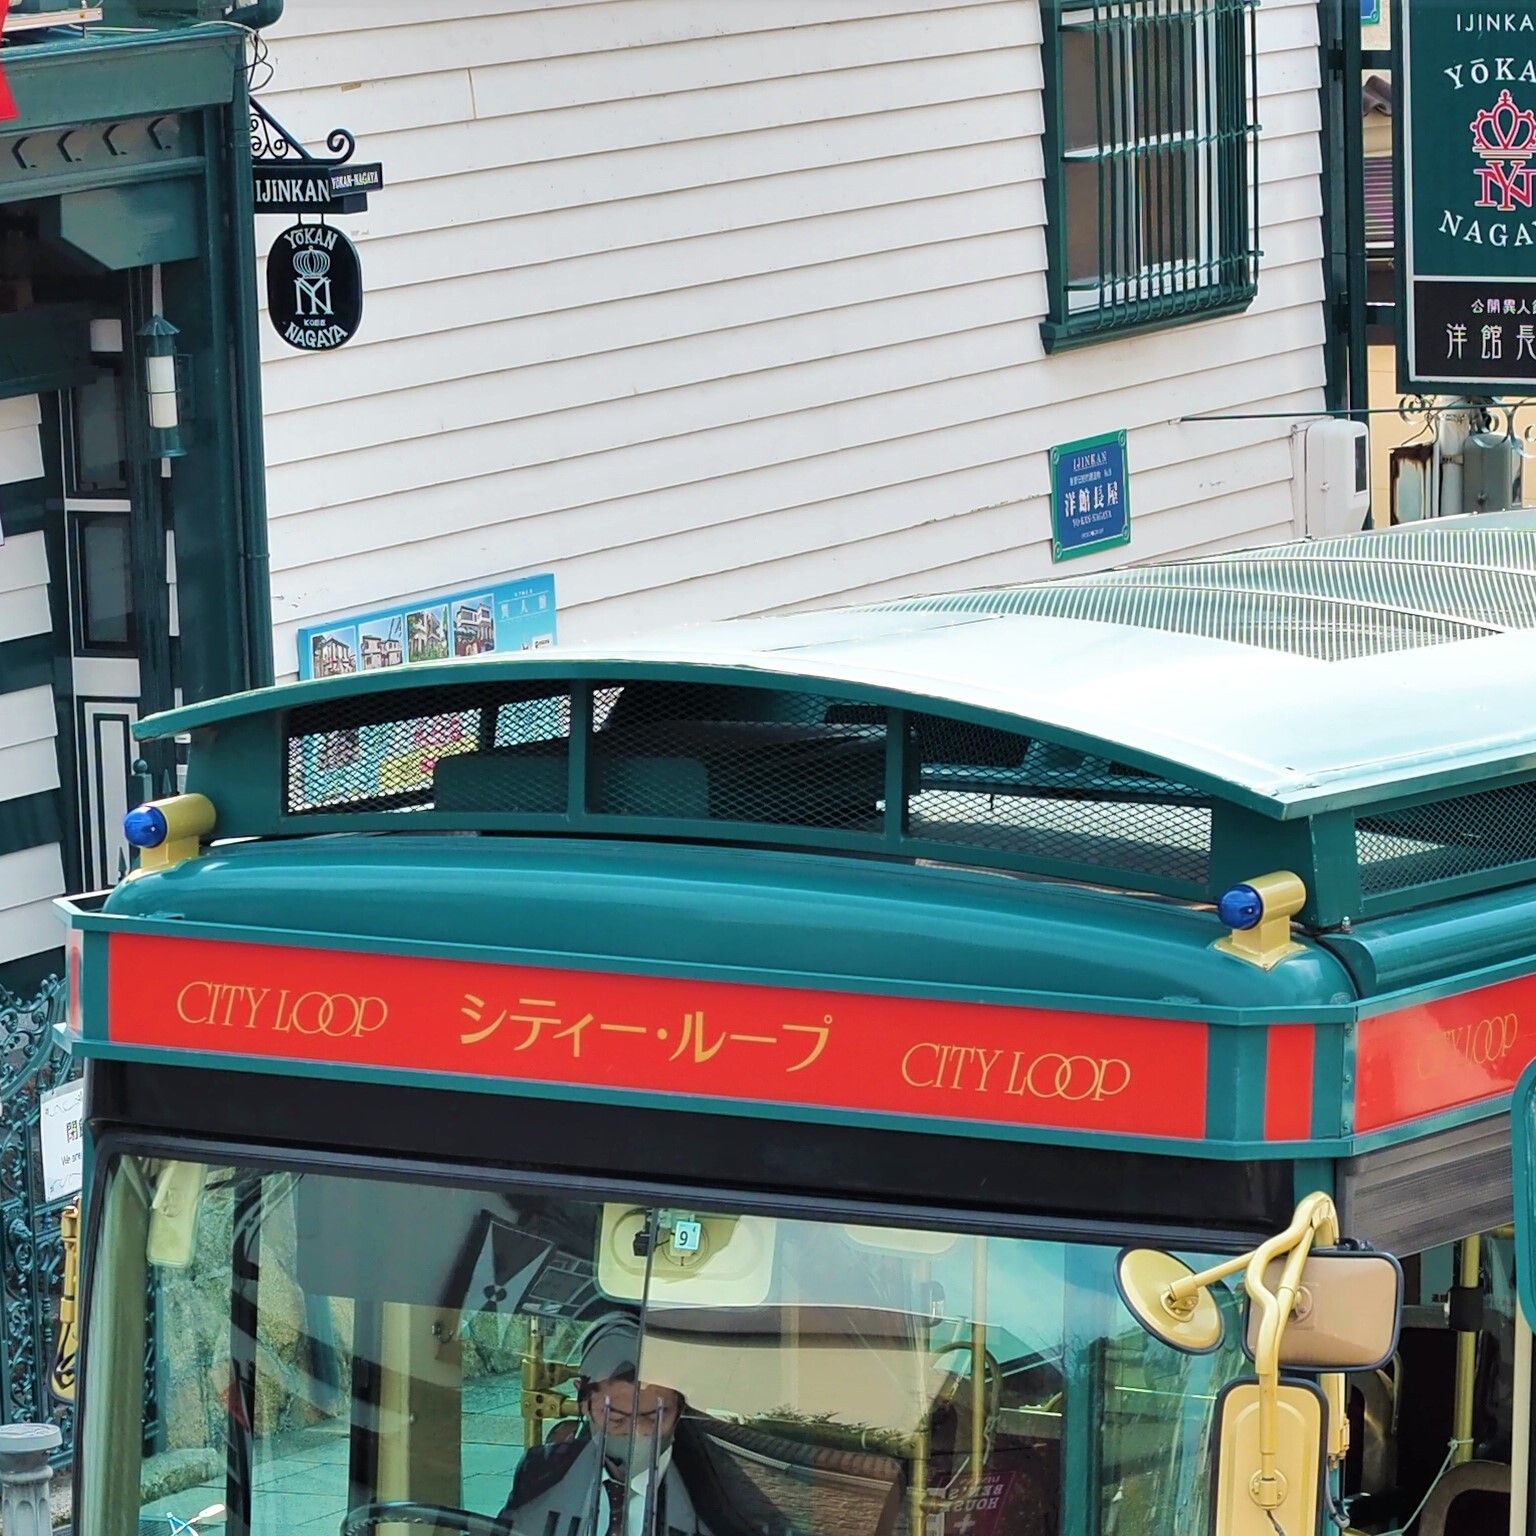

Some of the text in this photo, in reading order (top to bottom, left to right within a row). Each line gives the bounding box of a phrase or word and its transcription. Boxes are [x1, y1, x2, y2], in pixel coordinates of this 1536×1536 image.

[255, 178, 332, 203] IJINKAN
[284, 321, 348, 349] NAGAYA
[1064, 481, 1119, 518] 洋館長屋
[176, 980, 388, 1039] CITY LOOP
[460, 993, 833, 1073] シティー・ループ
[901, 1042, 1131, 1102] CITY LOOP
[679, 1230, 689, 1246] 9
